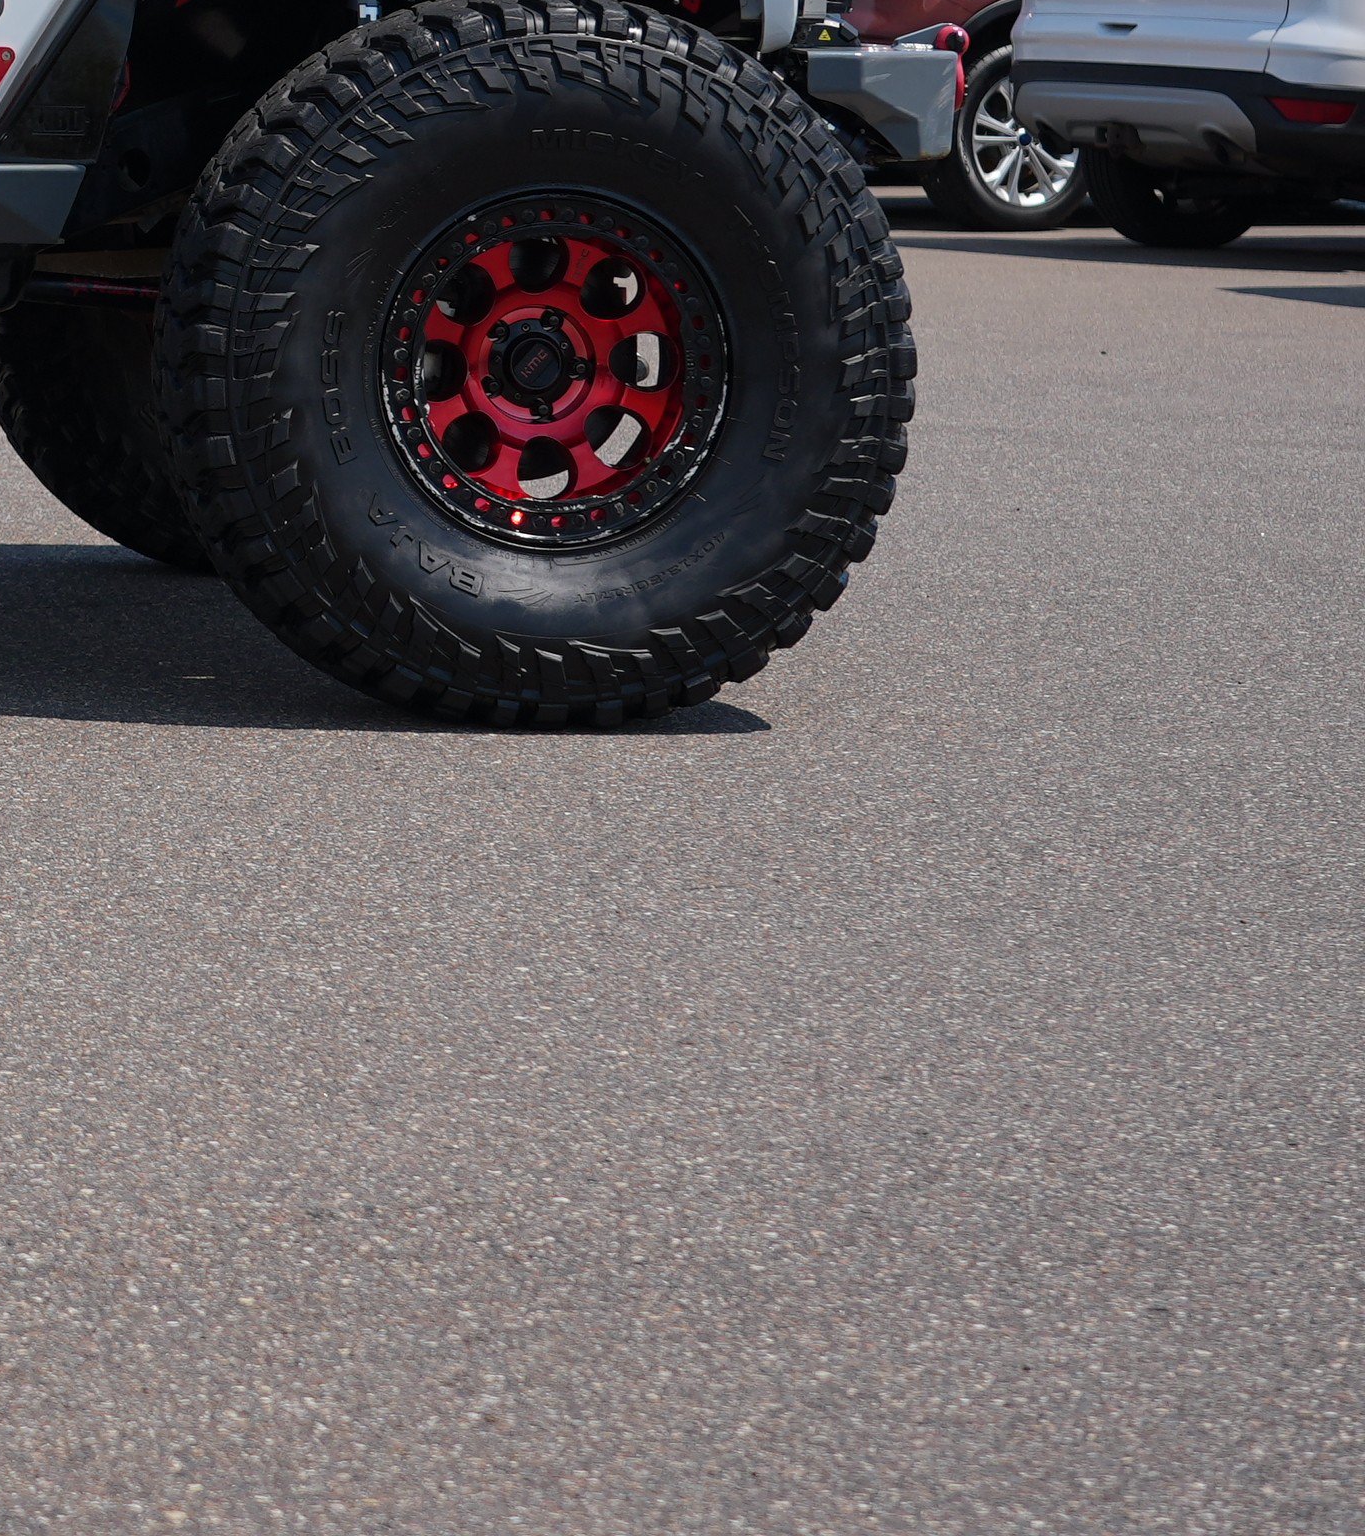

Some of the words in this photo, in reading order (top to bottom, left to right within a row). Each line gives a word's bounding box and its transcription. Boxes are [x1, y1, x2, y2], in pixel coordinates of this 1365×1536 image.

[530, 128, 705, 185] MICKEY
[320, 310, 358, 466] BOSS
[368, 491, 484, 598] BAJA
